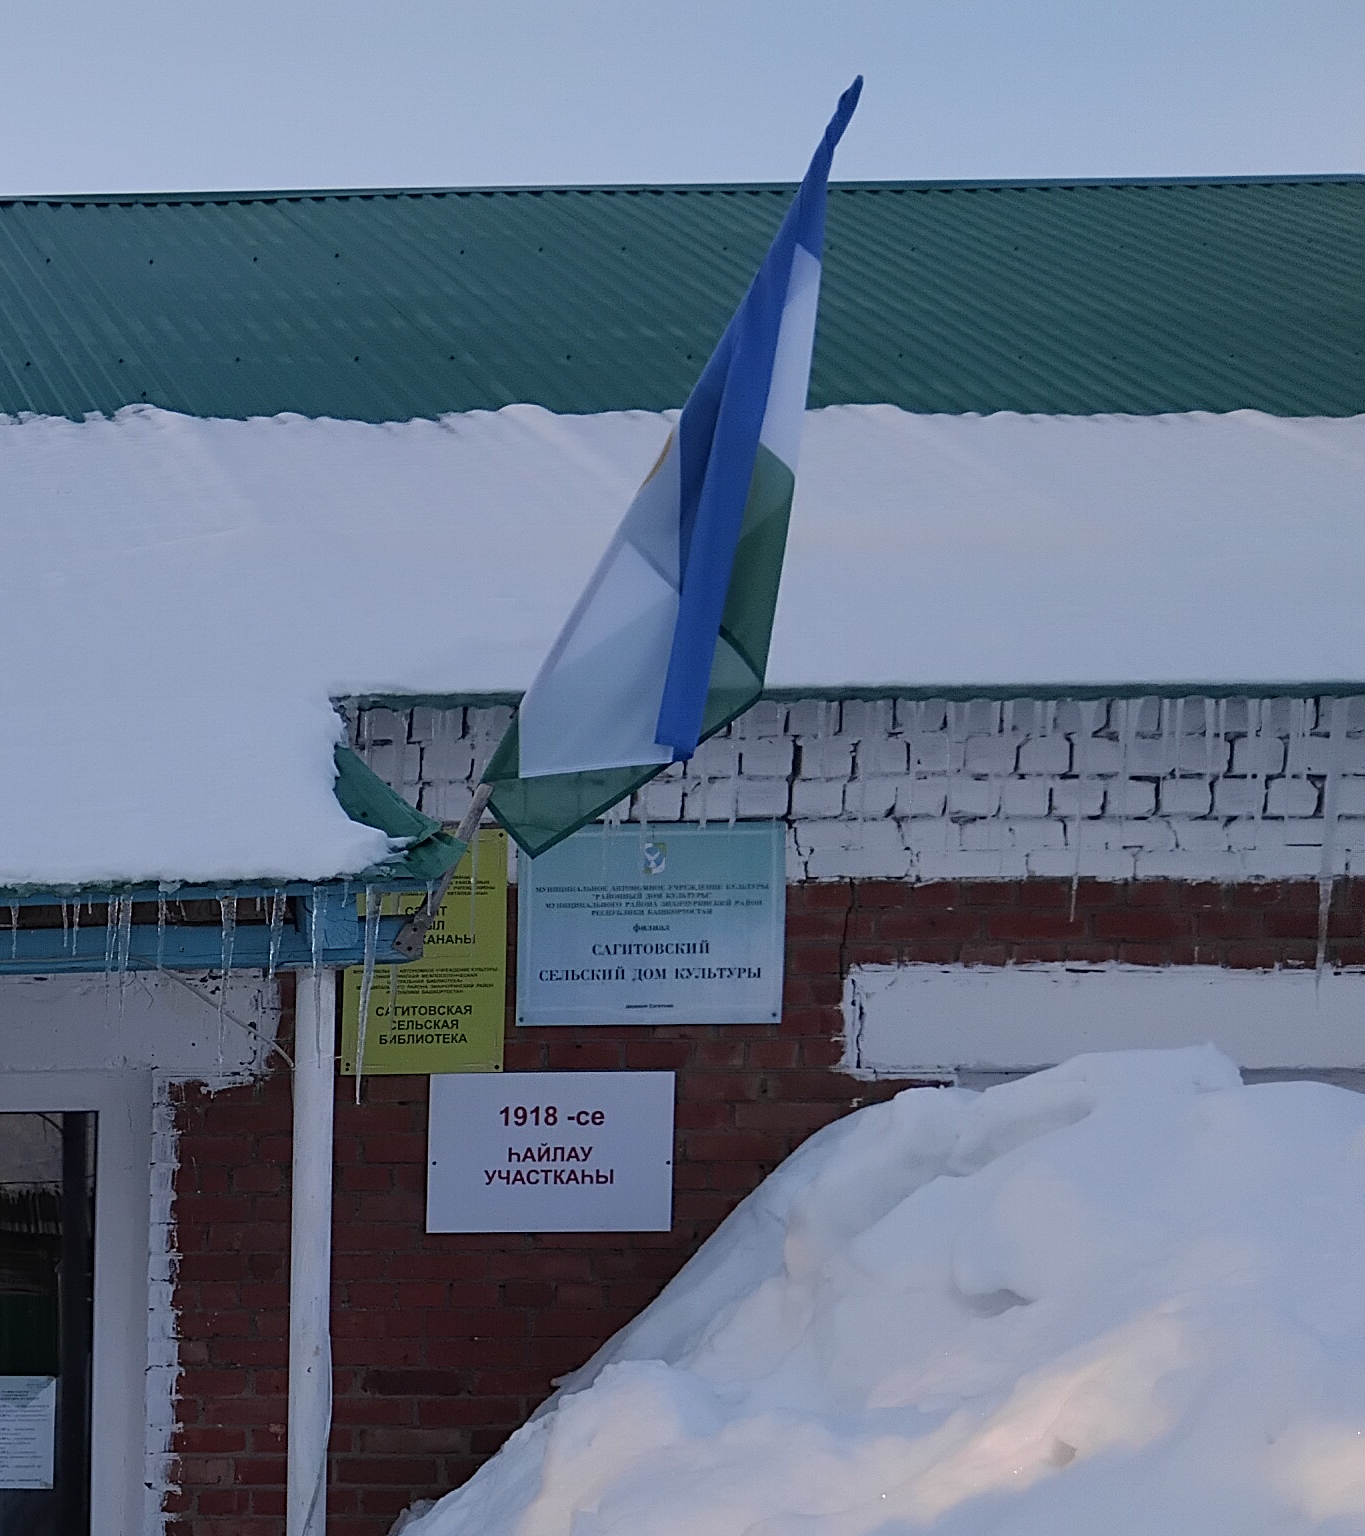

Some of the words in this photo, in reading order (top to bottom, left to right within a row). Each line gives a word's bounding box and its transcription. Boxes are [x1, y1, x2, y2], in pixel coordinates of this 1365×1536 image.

[633, 923, 670, 932] филиал
[591, 940, 710, 956] САГИТОВСКИЙ
[538, 966, 625, 981] СЕЛЬСКИЙ
[631, 968, 667, 981] ДОМ
[674, 967, 762, 980] КУЛЬТУРЫ
[379, 1033, 468, 1044] БИБЛИОТЕКА
[499, 1106, 558, 1127] 1918
[567, 1110, 605, 1126] -се
[507, 1143, 593, 1163] ҺАЙЛАУ
[484, 1169, 614, 1185] УЧАСТКАҺЫ
